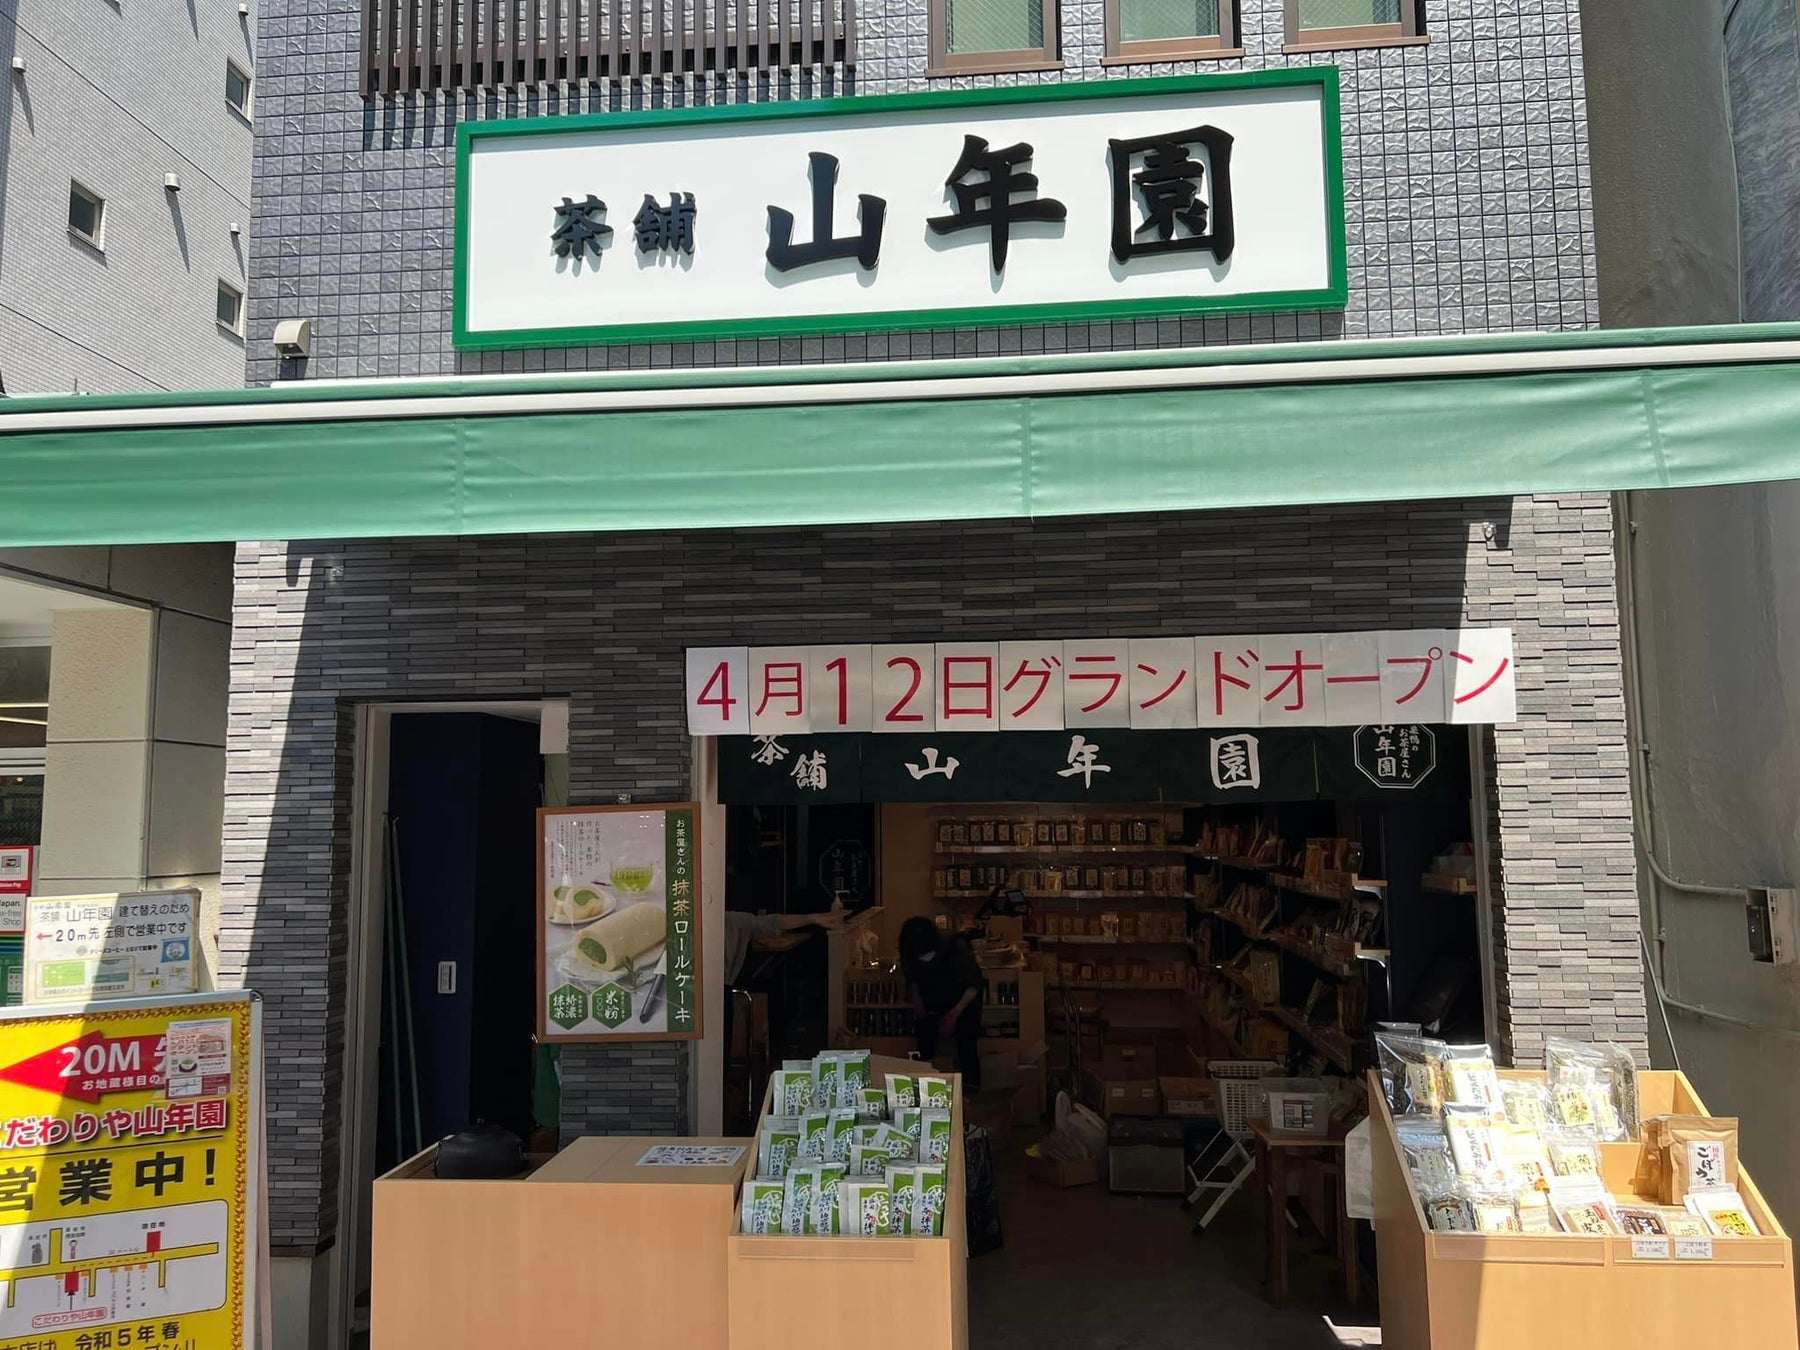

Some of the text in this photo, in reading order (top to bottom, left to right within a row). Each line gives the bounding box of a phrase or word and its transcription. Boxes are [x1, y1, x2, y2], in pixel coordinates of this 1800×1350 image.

[764, 125, 1236, 274] 山年園
[66, 906, 113, 923] 山年園
[672, 819, 691, 1023] お茶屋さんの 抹茶ロールケーキ
[104, 922, 187, 938] 左側で営業中です
[59, 1040, 141, 1078] 20M
[82, 1074, 166, 1091] お地蔵様目の
[0, 1100, 228, 1149] だわりや山年園
[34, 1309, 105, 1326] こだわりや山年園
[76, 1321, 180, 1350] 令和5年春
